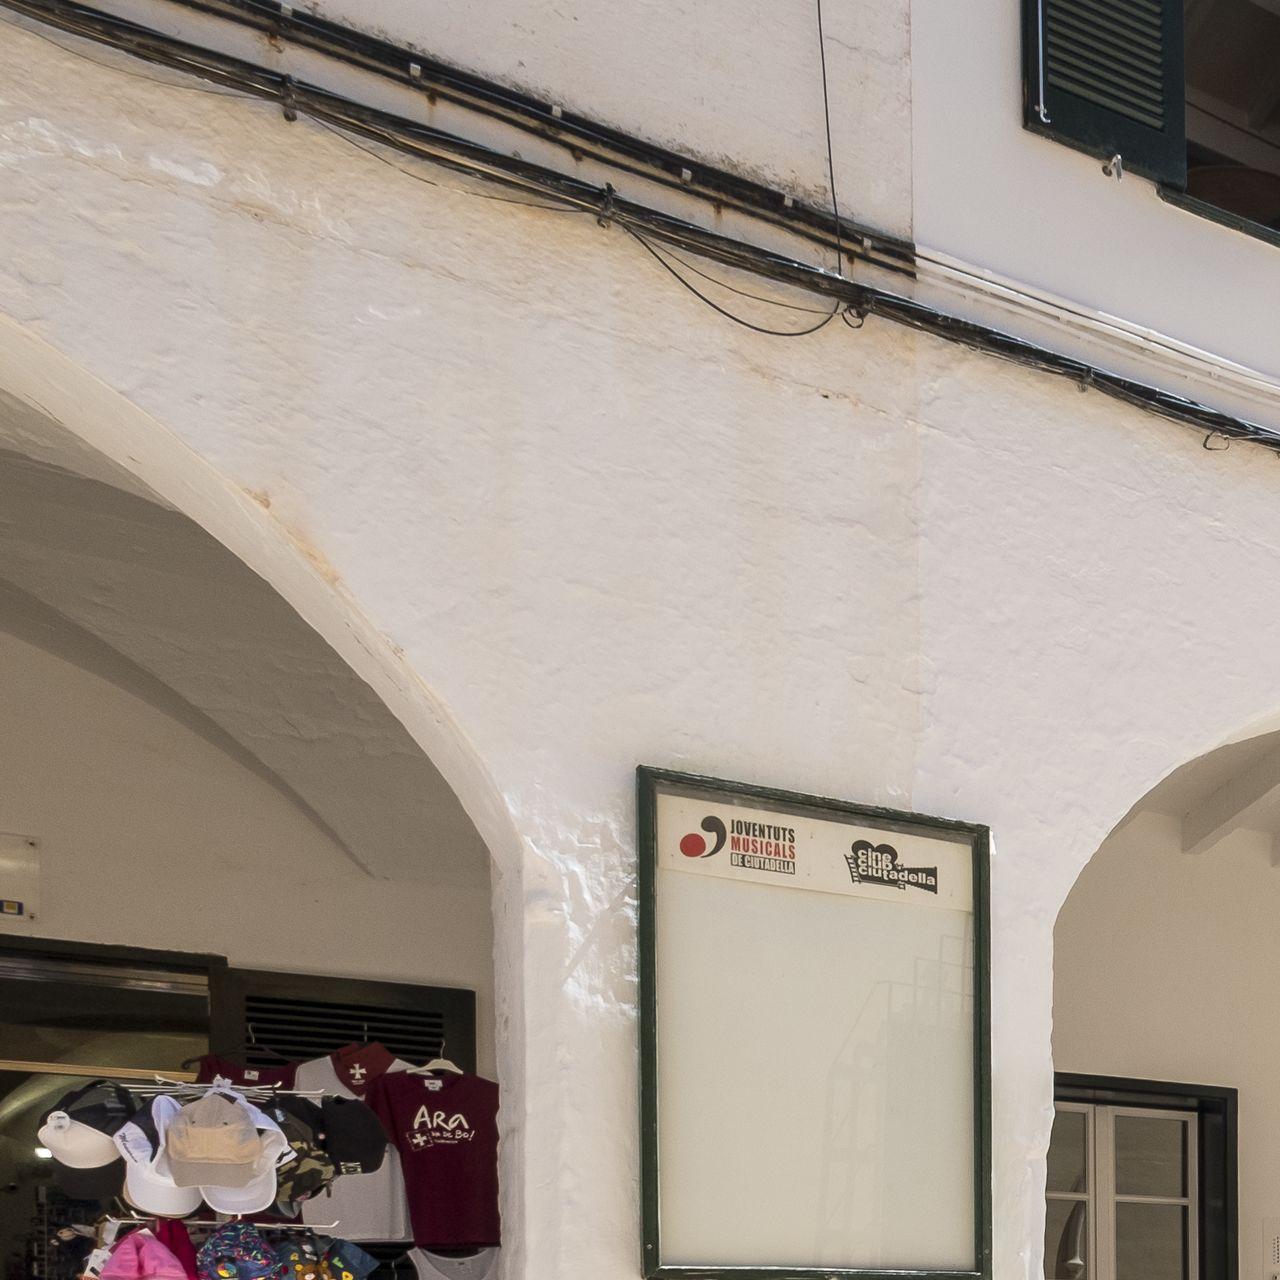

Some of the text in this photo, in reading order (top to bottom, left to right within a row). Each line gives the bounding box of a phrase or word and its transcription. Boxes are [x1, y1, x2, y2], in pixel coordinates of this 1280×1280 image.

[730, 819, 796, 843] JOVENTUTS
[730, 836, 796, 860] MUSICALS
[858, 849, 891, 863] cine
[732, 854, 795, 874] DE CIUTADELLA
[858, 857, 893, 871] club
[858, 866, 936, 887] ciutadella
